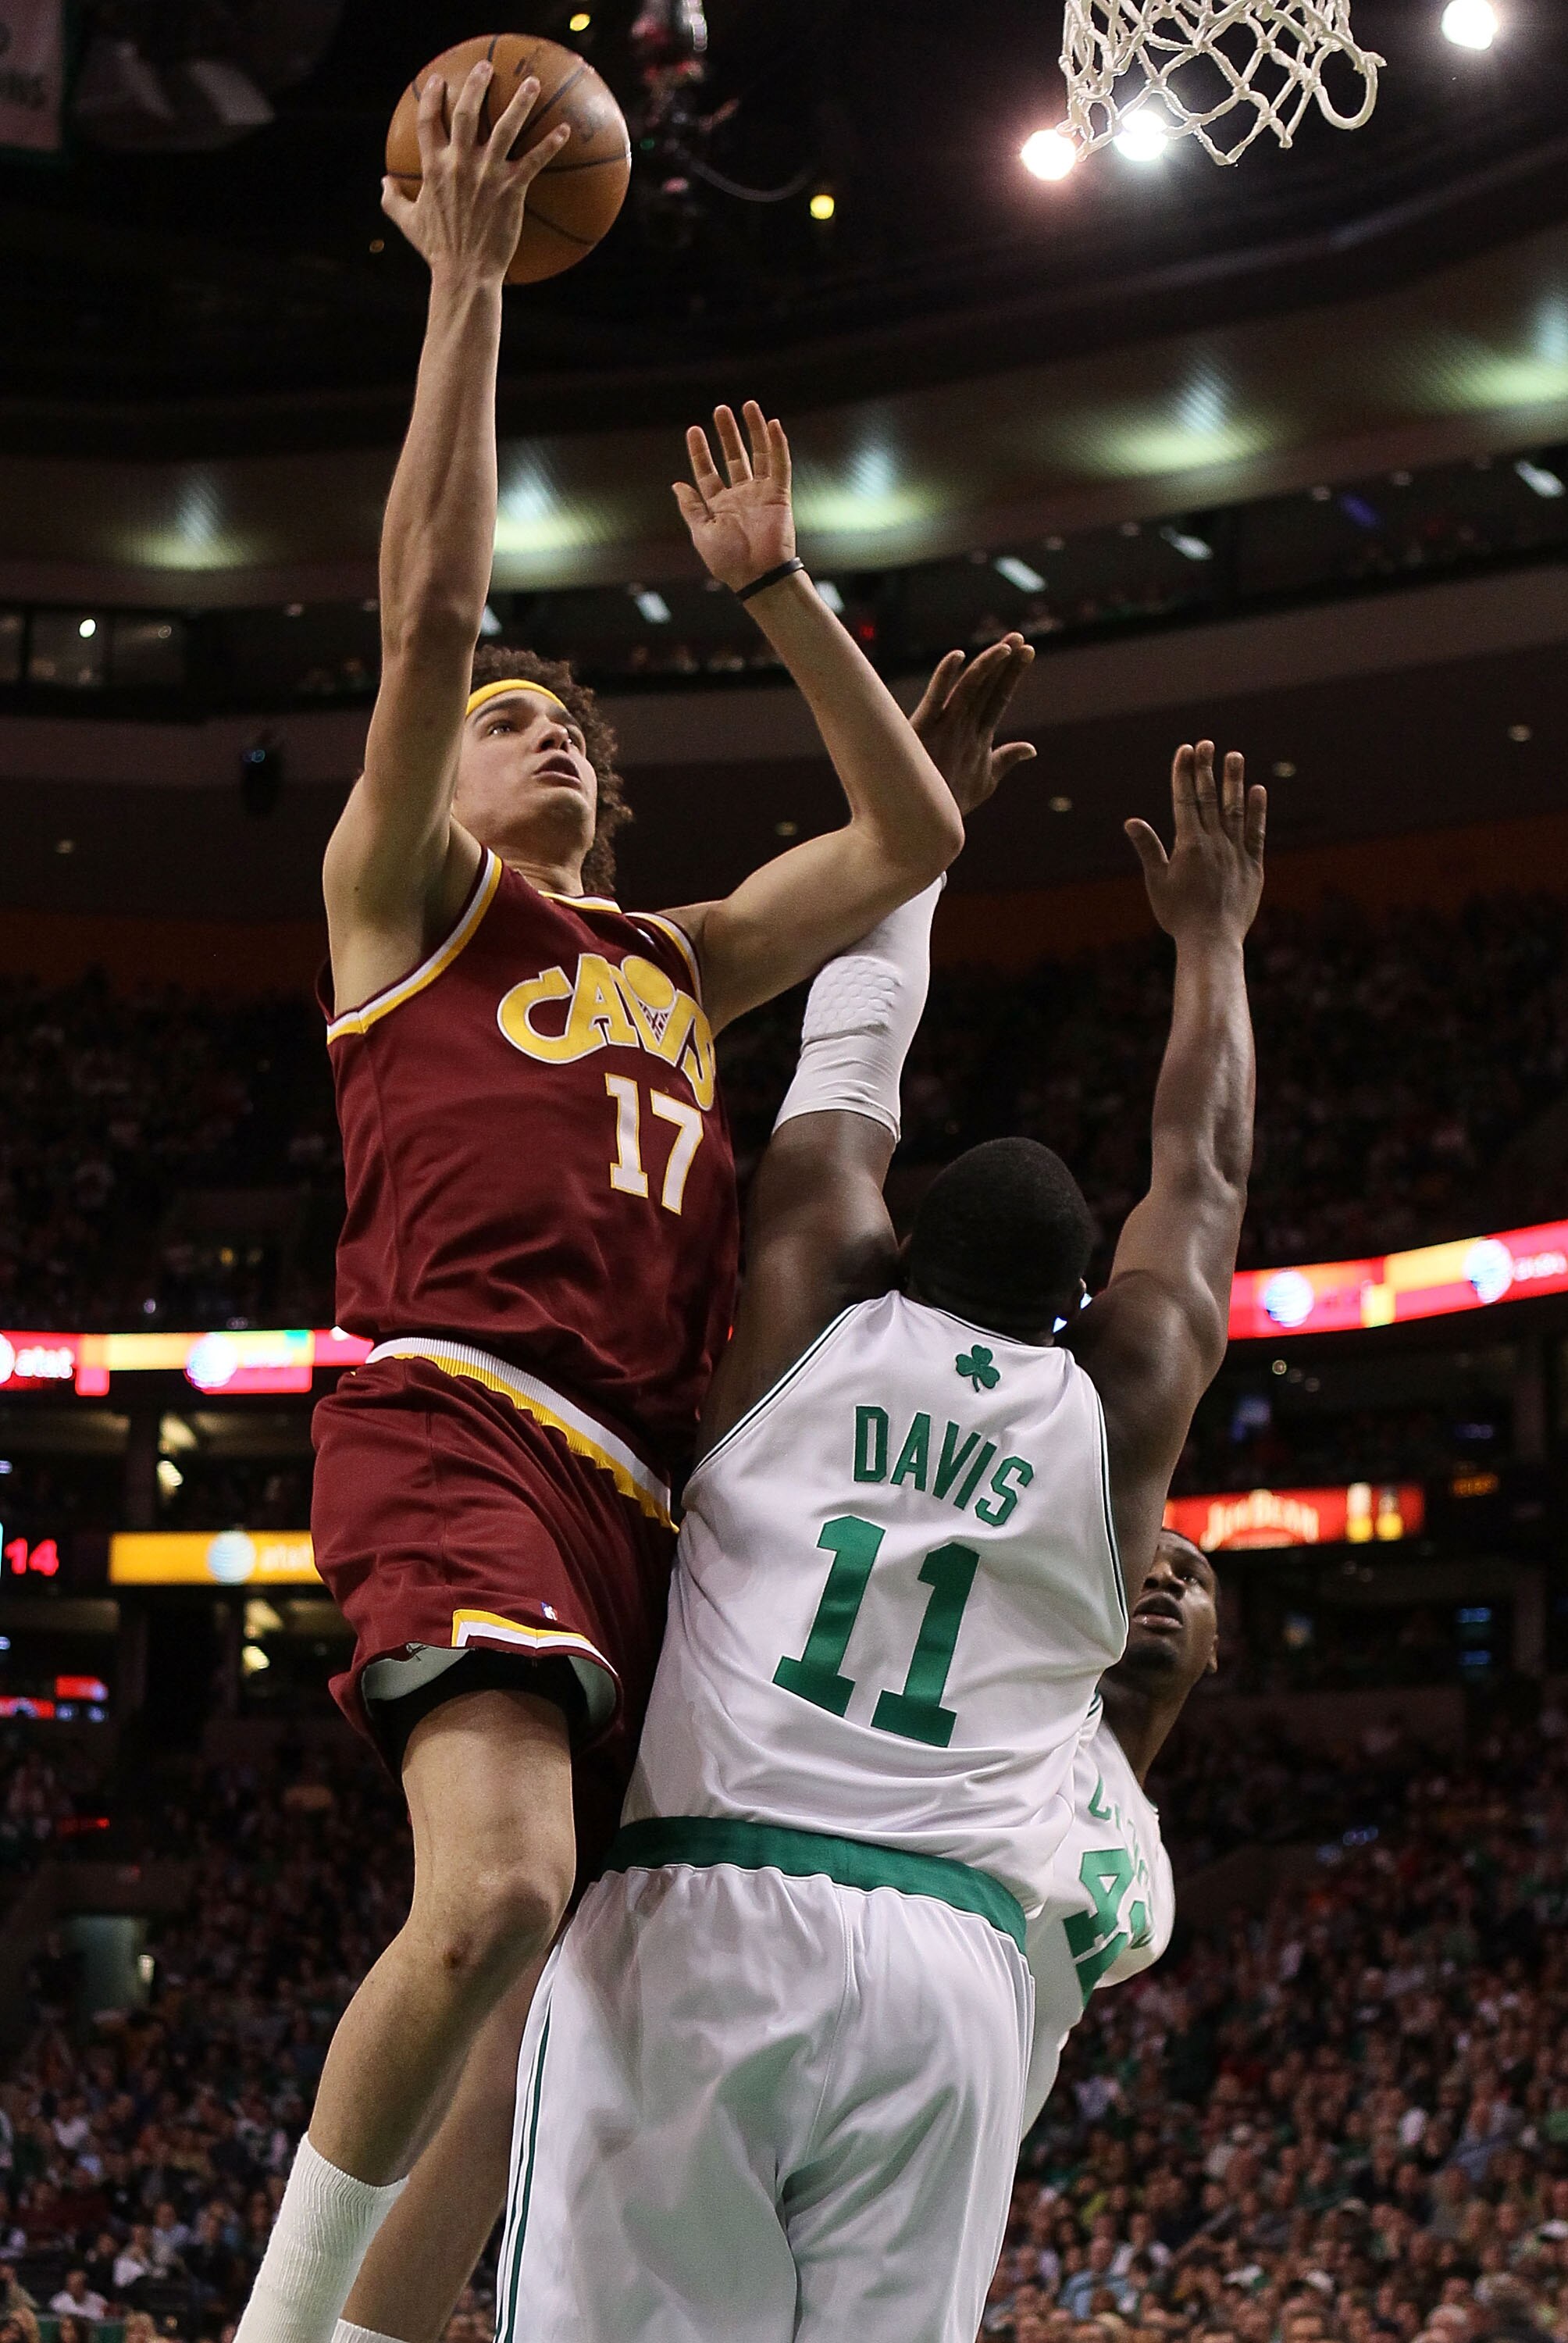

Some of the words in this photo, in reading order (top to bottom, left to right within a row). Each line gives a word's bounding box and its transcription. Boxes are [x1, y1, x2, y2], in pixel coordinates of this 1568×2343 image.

[497, 952, 716, 1111] CAVS
[605, 1072, 704, 1215] 17
[853, 1405, 1035, 1527] DAVIS
[4, 1537, 59, 1577] 14
[772, 1514, 981, 1748] 11
